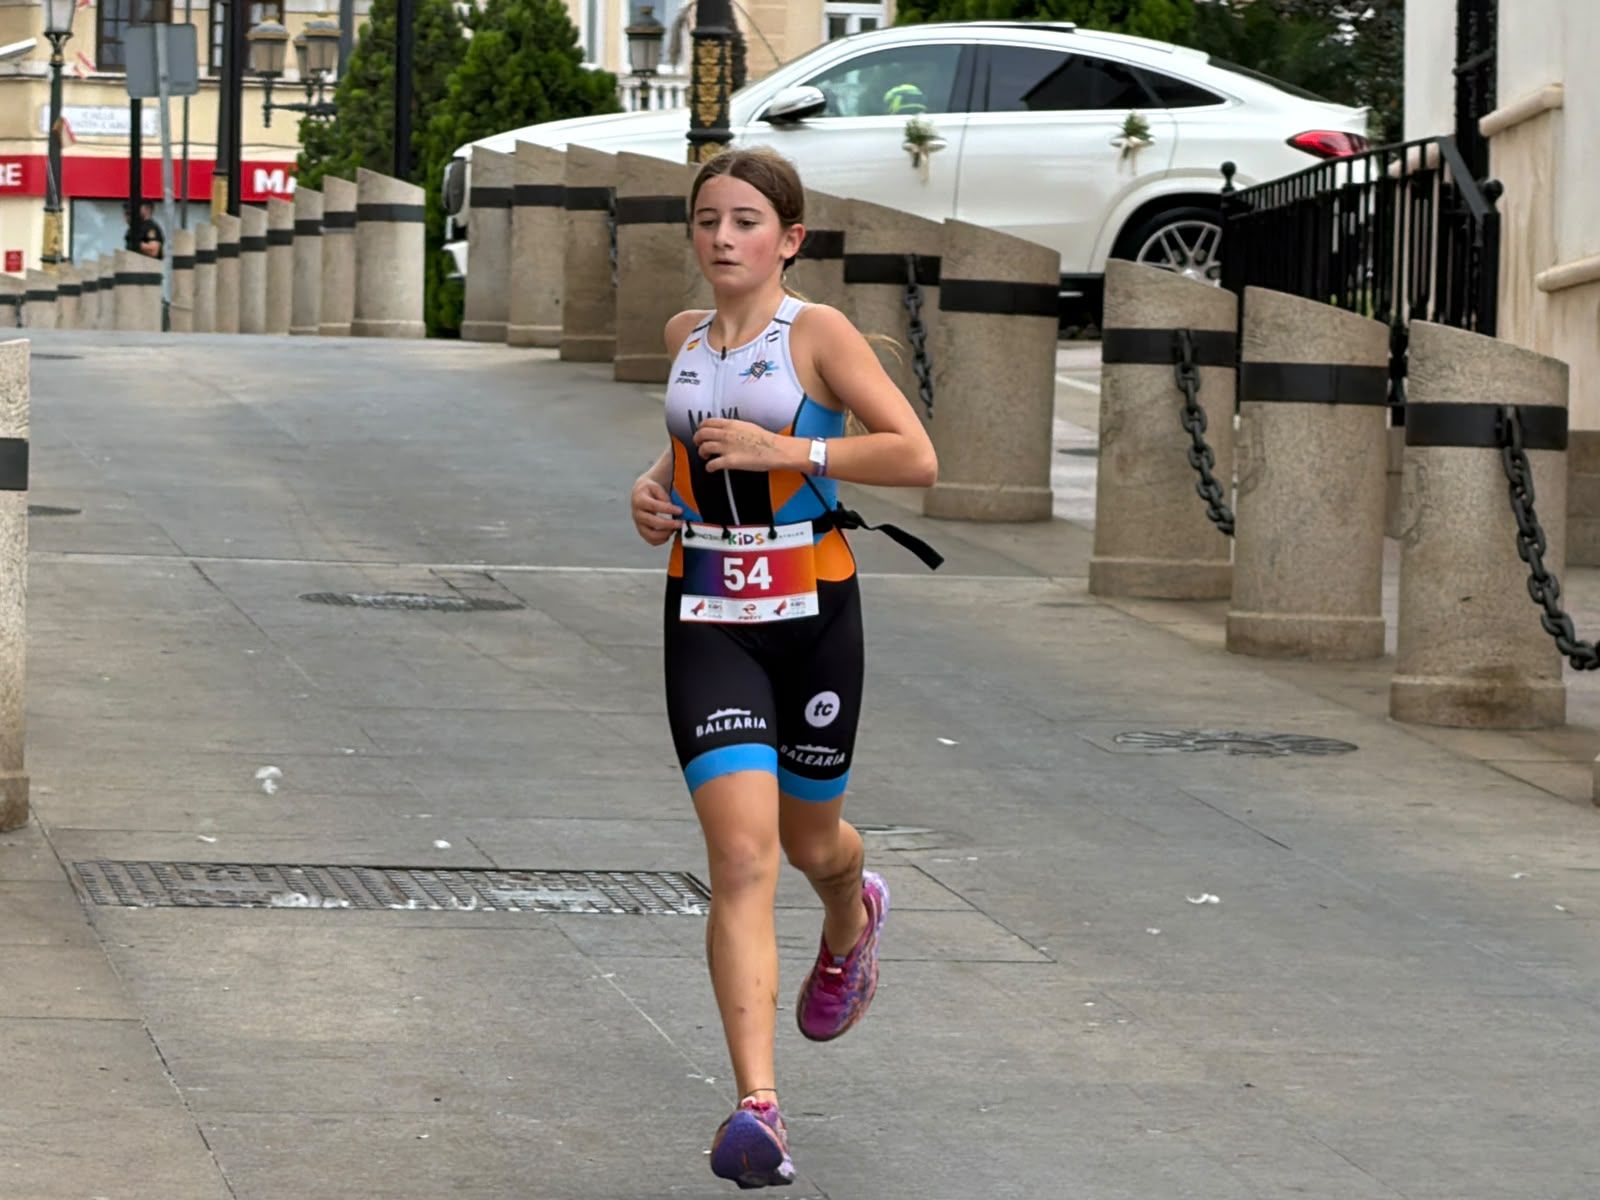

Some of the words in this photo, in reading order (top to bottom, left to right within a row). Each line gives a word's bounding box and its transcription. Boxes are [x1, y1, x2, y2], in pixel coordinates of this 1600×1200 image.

[0, 163, 22, 186] E
[723, 556, 773, 591] 54
[814, 700, 834, 717] tc
